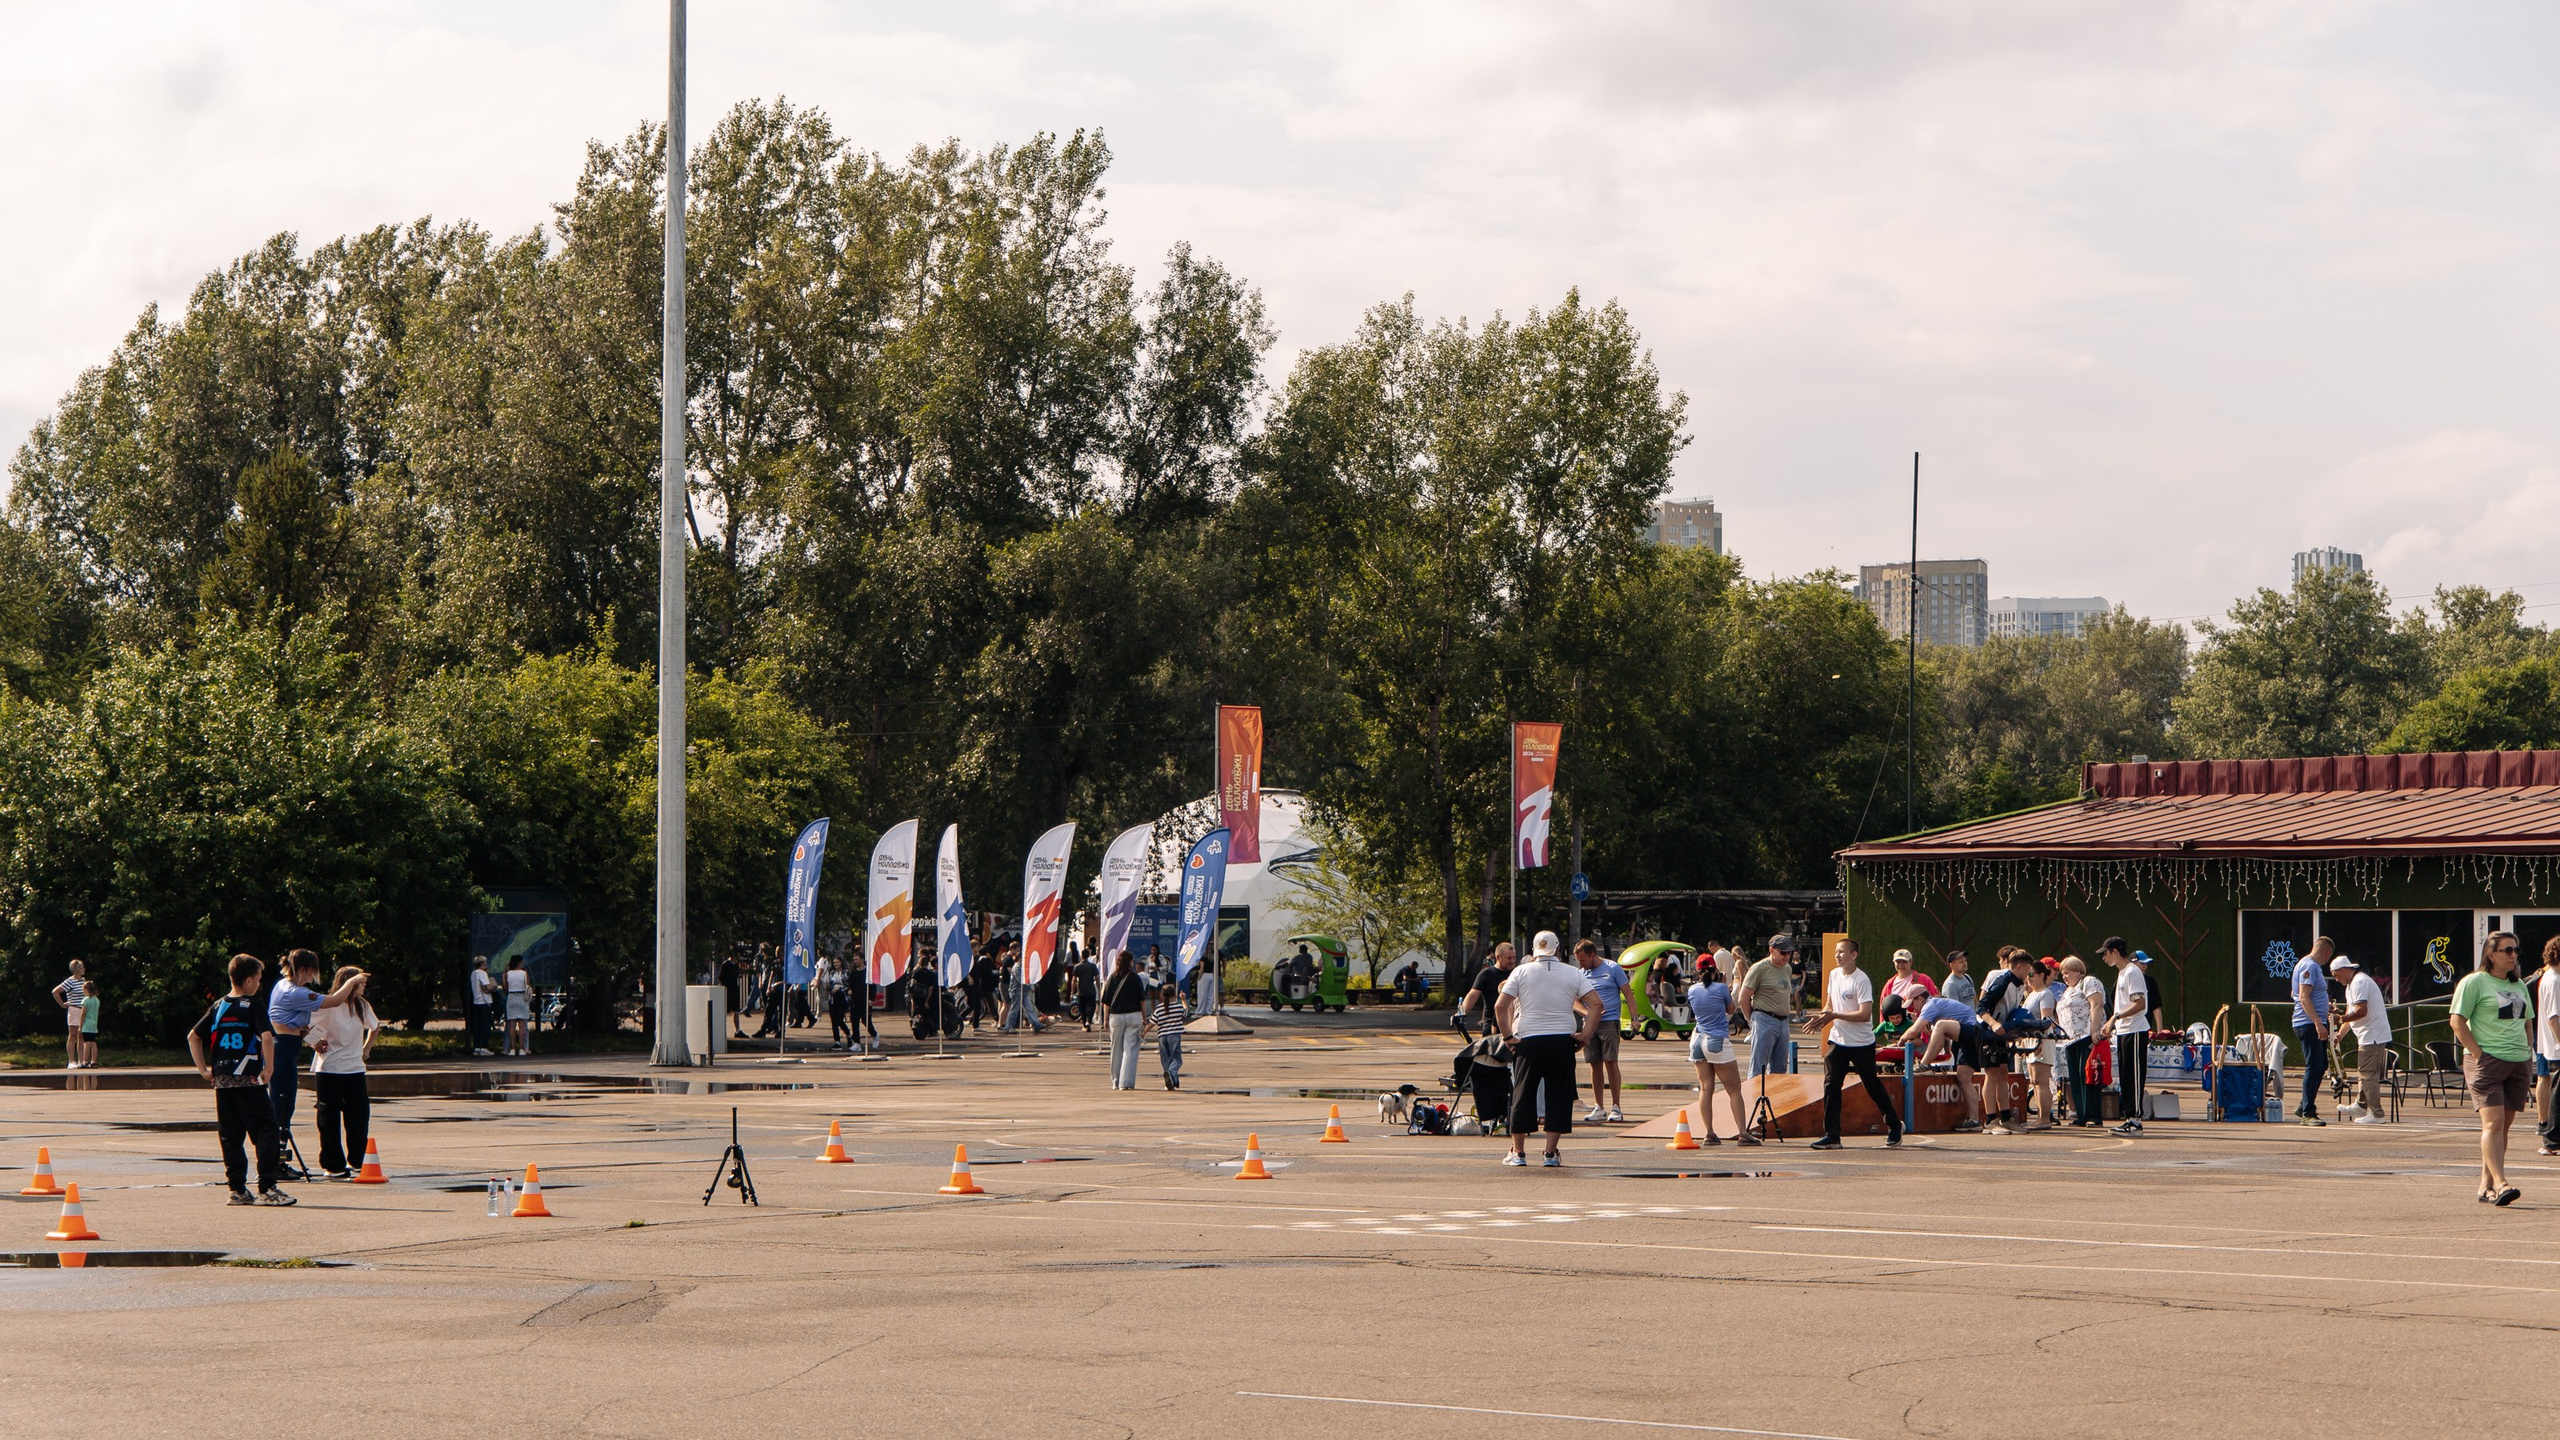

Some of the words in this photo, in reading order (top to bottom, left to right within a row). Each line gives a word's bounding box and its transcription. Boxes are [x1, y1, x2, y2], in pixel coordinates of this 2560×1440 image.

[911, 916, 937, 928] ОРОЖЕ
[1132, 918, 1153, 926] ЖАЗ
[1200, 906, 1208, 924] 2026
[220, 1032, 243, 1050] 48
[1925, 1084, 1964, 1103] СШО
